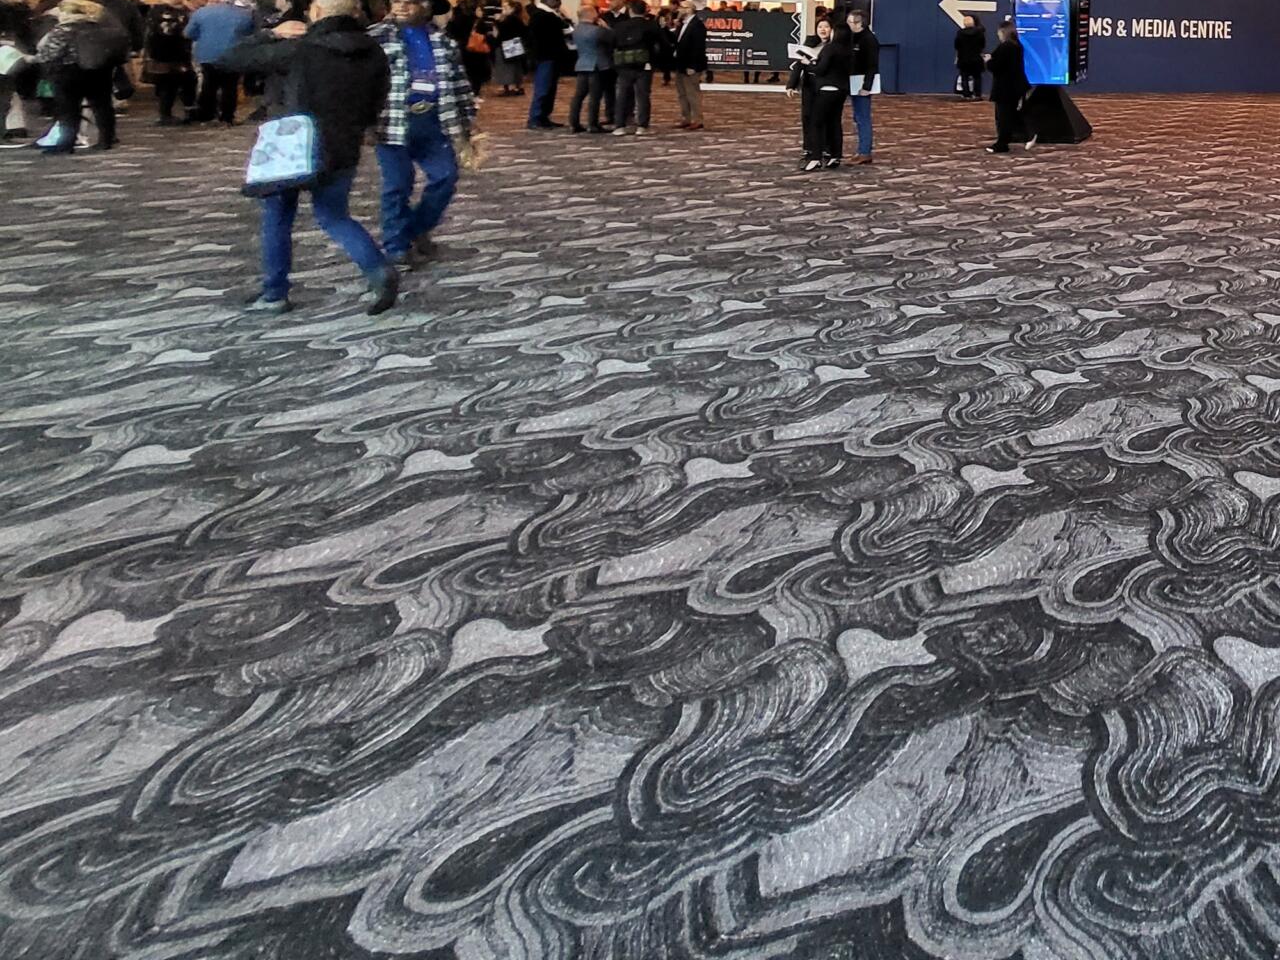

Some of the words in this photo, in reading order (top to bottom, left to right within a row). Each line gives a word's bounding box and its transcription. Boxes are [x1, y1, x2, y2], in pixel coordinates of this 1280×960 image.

[1117, 20, 1128, 37] &
[1131, 20, 1177, 39] MEDIA
[1180, 21, 1233, 39] CENTRE
